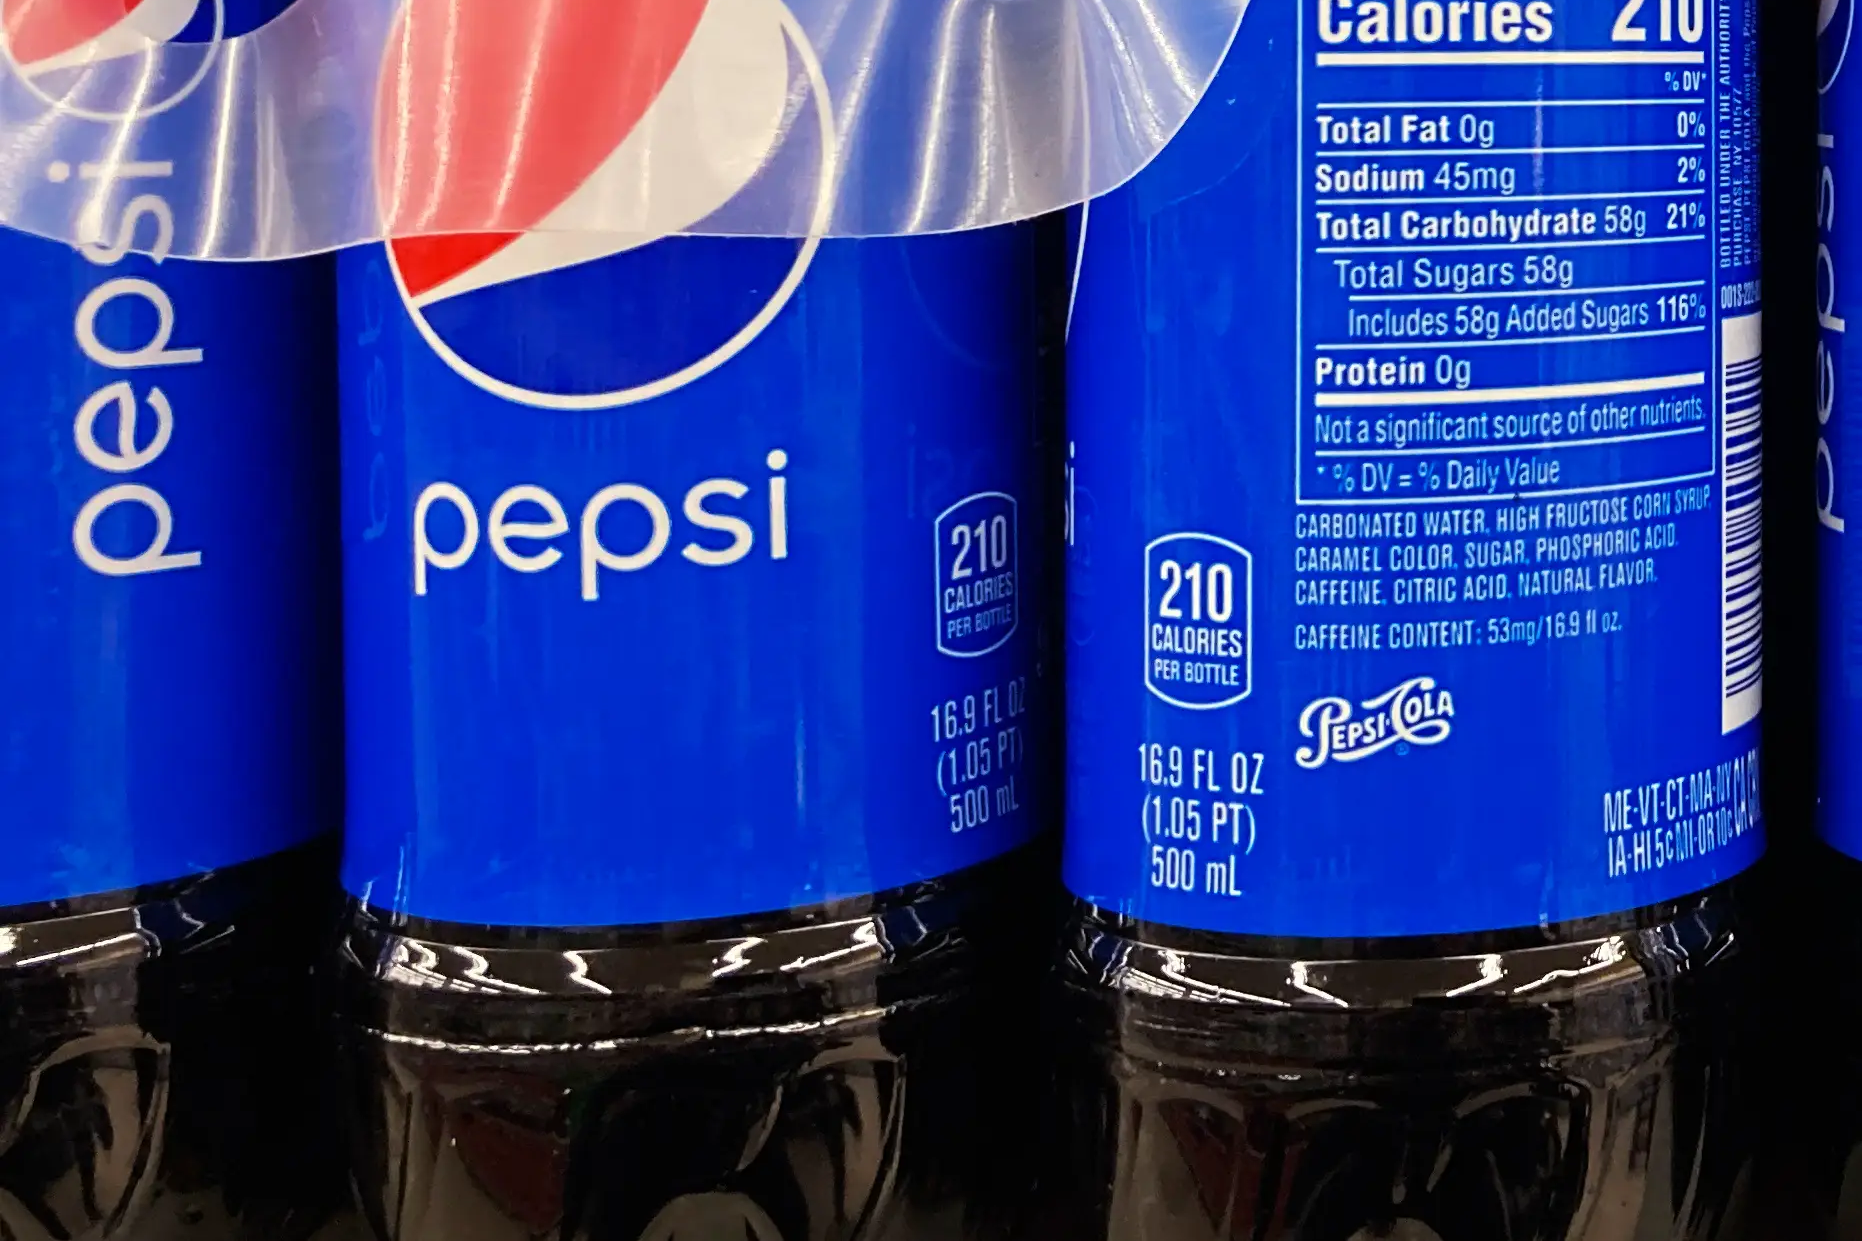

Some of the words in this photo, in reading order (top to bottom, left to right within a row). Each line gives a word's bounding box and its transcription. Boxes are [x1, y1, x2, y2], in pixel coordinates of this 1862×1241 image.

[1676, 111, 1706, 139] 0%
[1719, 92, 1731, 122] THE
[1315, 114, 1391, 144] Total
[1400, 114, 1451, 144] Fat
[1459, 114, 1495, 149] 0g
[1315, 163, 1425, 193] Sodium
[1433, 161, 1516, 196] 45mg
[1676, 156, 1706, 184] 2%
[1719, 128, 1731, 187] UNDER
[1315, 211, 1391, 241] Total
[1400, 206, 1597, 243] Carbohydrate
[1603, 205, 1647, 237] 58g
[1666, 201, 1706, 231] 21%
[1719, 193, 1732, 269] BOTTLED
[1334, 258, 1404, 290] Total
[1413, 256, 1515, 295] Sugars
[1523, 254, 1574, 290] 58g
[1348, 306, 1450, 338] Includes
[1454, 306, 1500, 340] 58g
[1505, 304, 1577, 334] Added
[1581, 298, 1649, 334] Sugars
[1656, 295, 1706, 323] 116%
[47, 160, 204, 577] pepsi
[1315, 355, 1426, 386] Protein
[1435, 354, 1472, 390] 0g
[1315, 413, 1353, 445] Not
[1356, 421, 1371, 442] a
[1375, 410, 1489, 449] significant
[1493, 409, 1563, 439] source
[1567, 404, 1588, 432] of
[1590, 401, 1636, 430] other
[1639, 395, 1706, 428] nutrients.
[1361, 462, 1394, 492] DV
[1447, 459, 1501, 495] Daily
[1504, 457, 1561, 487] Value
[413, 449, 788, 600] pepsi
[1295, 511, 1417, 539] CARBONATED
[1496, 504, 1540, 533] HIGH
[1546, 495, 1629, 529] FRUCTOSE
[1633, 491, 1671, 521] CORN
[951, 514, 1008, 582] 210
[1295, 545, 1383, 572] CARAMEL
[1536, 527, 1640, 563] PHOSPHORIC
[944, 571, 1014, 613] CALORIES
[1159, 560, 1233, 622] 210
[1394, 576, 1457, 605] CITRIC
[1518, 566, 1595, 598] NATURAL
[947, 616, 972, 639] PER
[975, 603, 1013, 633] BOTTLE
[1151, 623, 1243, 658] CALORIES
[1295, 623, 1382, 650] CAFFEINE
[1388, 619, 1482, 648] CONTENT:
[1487, 610, 1580, 646] 53mg/16.9
[1153, 658, 1181, 681] PER
[1184, 661, 1240, 687] BOTTLE
[931, 694, 976, 743] 16.9
[983, 688, 1004, 728] FL
[936, 736, 991, 797] (1.05
[1138, 742, 1183, 788] 16.9
[1193, 749, 1221, 793] FL
[1231, 751, 1265, 795] OZ
[950, 784, 990, 834] 500
[1141, 793, 1202, 844] (1.05
[1212, 802, 1257, 855] PT)
[1151, 844, 1195, 892] 500
[1205, 854, 1242, 897] mL
